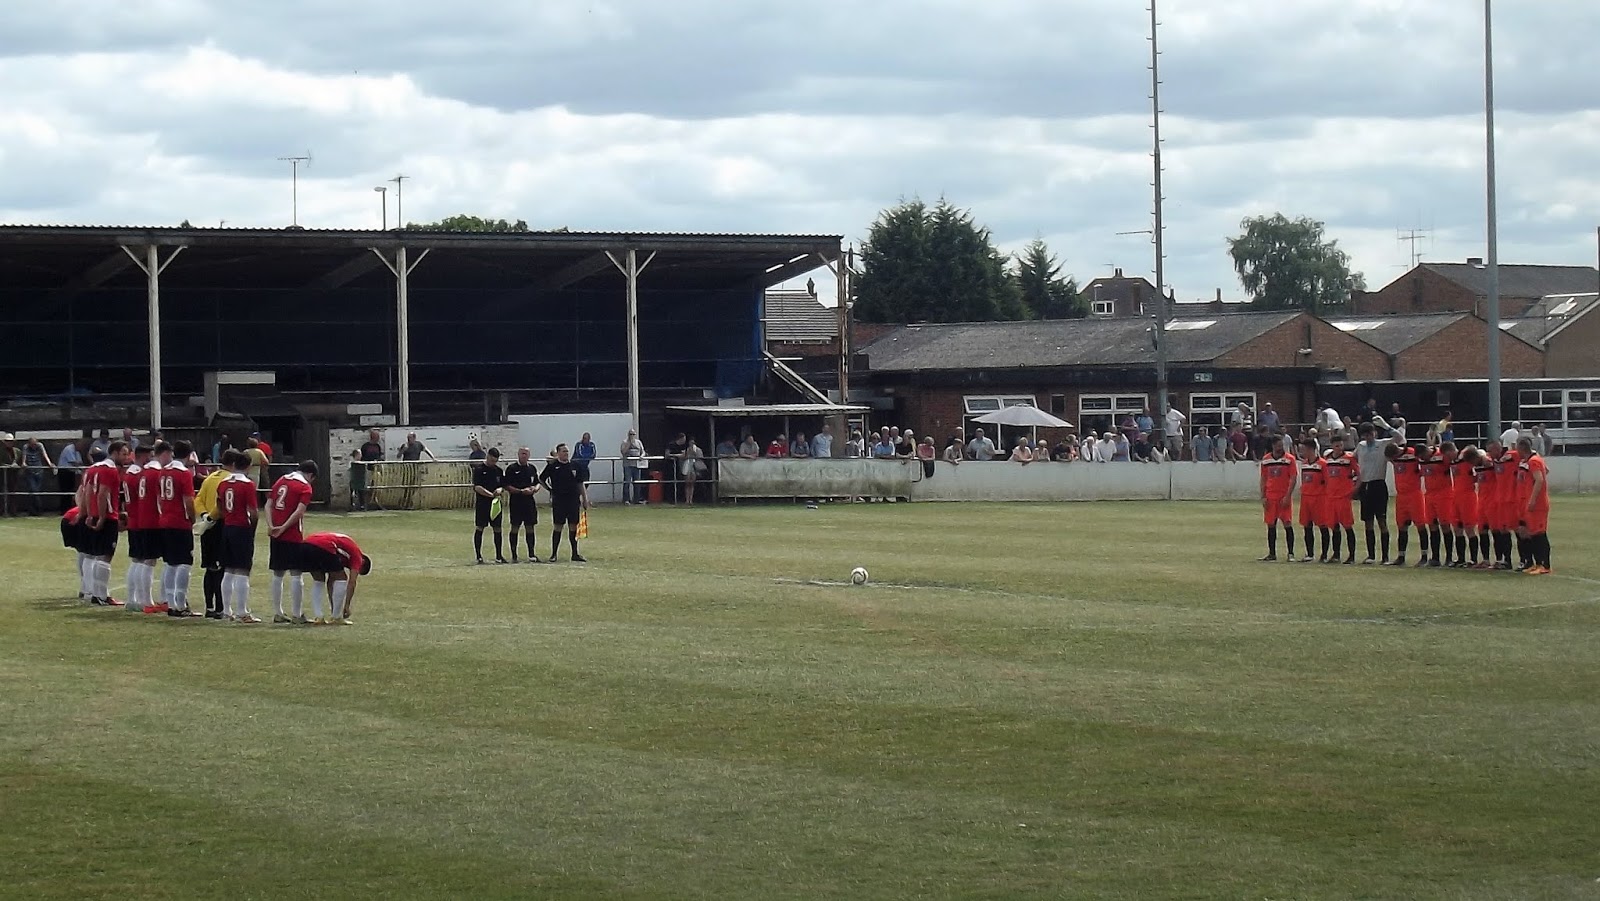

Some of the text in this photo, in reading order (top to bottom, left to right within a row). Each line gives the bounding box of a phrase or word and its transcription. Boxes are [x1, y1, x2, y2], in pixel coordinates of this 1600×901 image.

[138, 476, 146, 500] 6
[160, 475, 174, 501] 19
[225, 487, 234, 513] 8
[275, 485, 288, 509] 2
